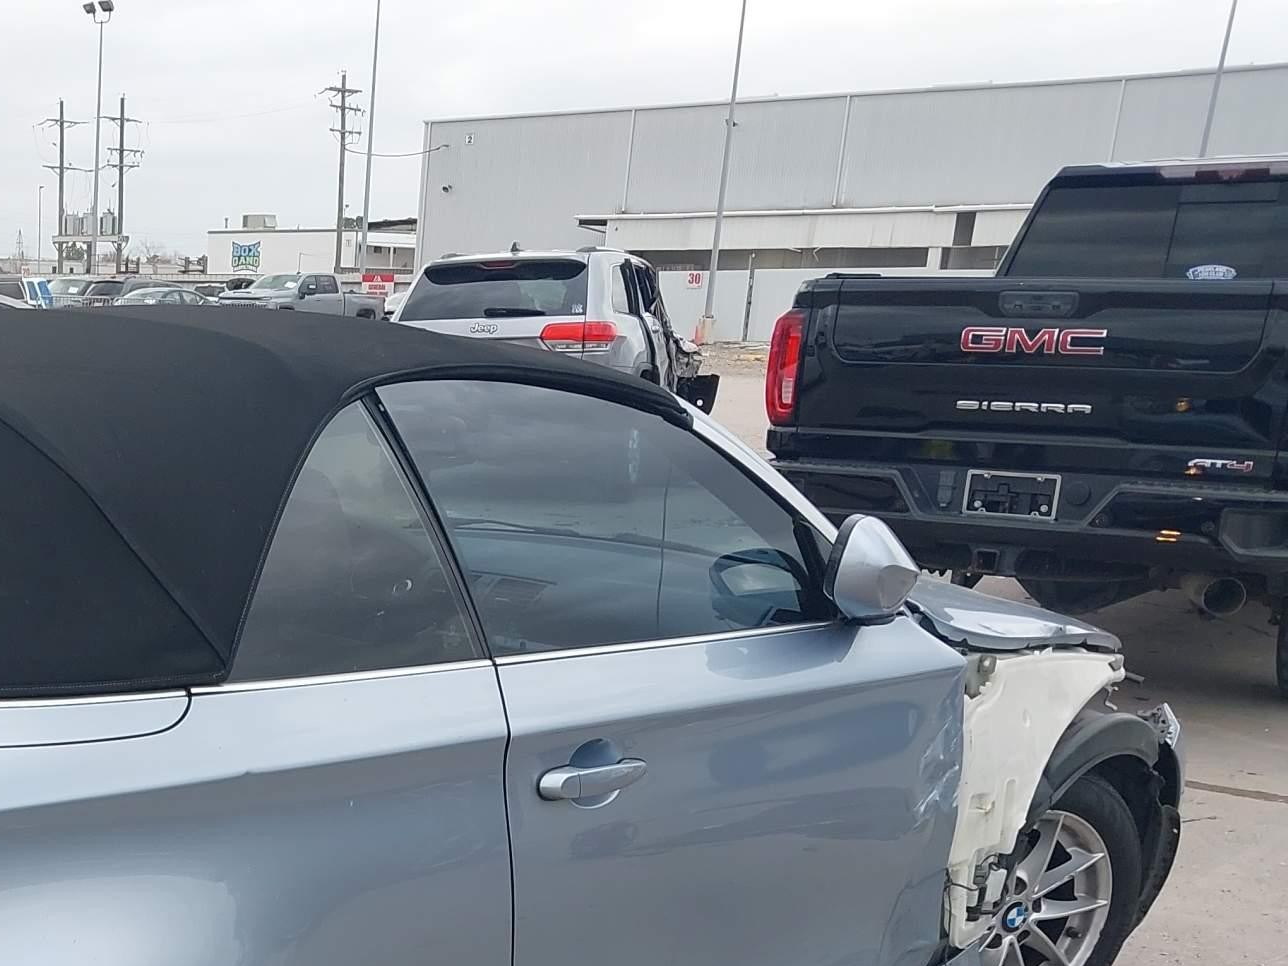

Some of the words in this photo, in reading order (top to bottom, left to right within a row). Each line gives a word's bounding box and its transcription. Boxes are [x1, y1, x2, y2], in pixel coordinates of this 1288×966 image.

[232, 241, 261, 257] BOX
[688, 272, 701, 285] 30
[470, 322, 497, 334] Jeep
[959, 325, 1109, 356] GMC
[955, 400, 1093, 415] SIERRA
[1187, 458, 1254, 473] AT4
